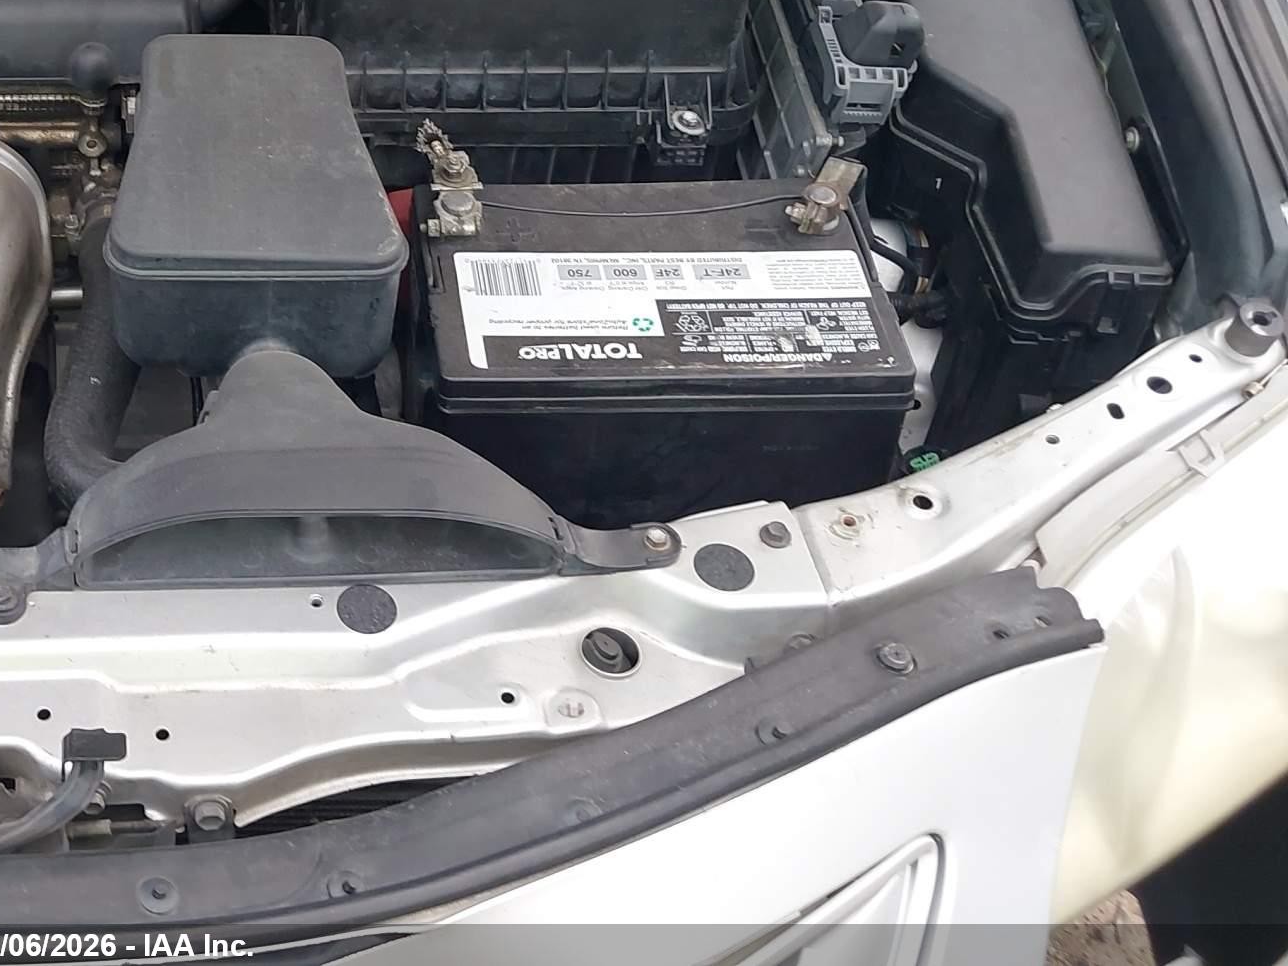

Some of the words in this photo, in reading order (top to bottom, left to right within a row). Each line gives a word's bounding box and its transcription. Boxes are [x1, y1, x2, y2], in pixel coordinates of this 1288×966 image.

[567, 269, 593, 278] 750
[612, 268, 638, 278] 600
[655, 268, 680, 277] 24F
[703, 267, 742, 277] 24F-T
[518, 342, 643, 360] TOTALPRO
